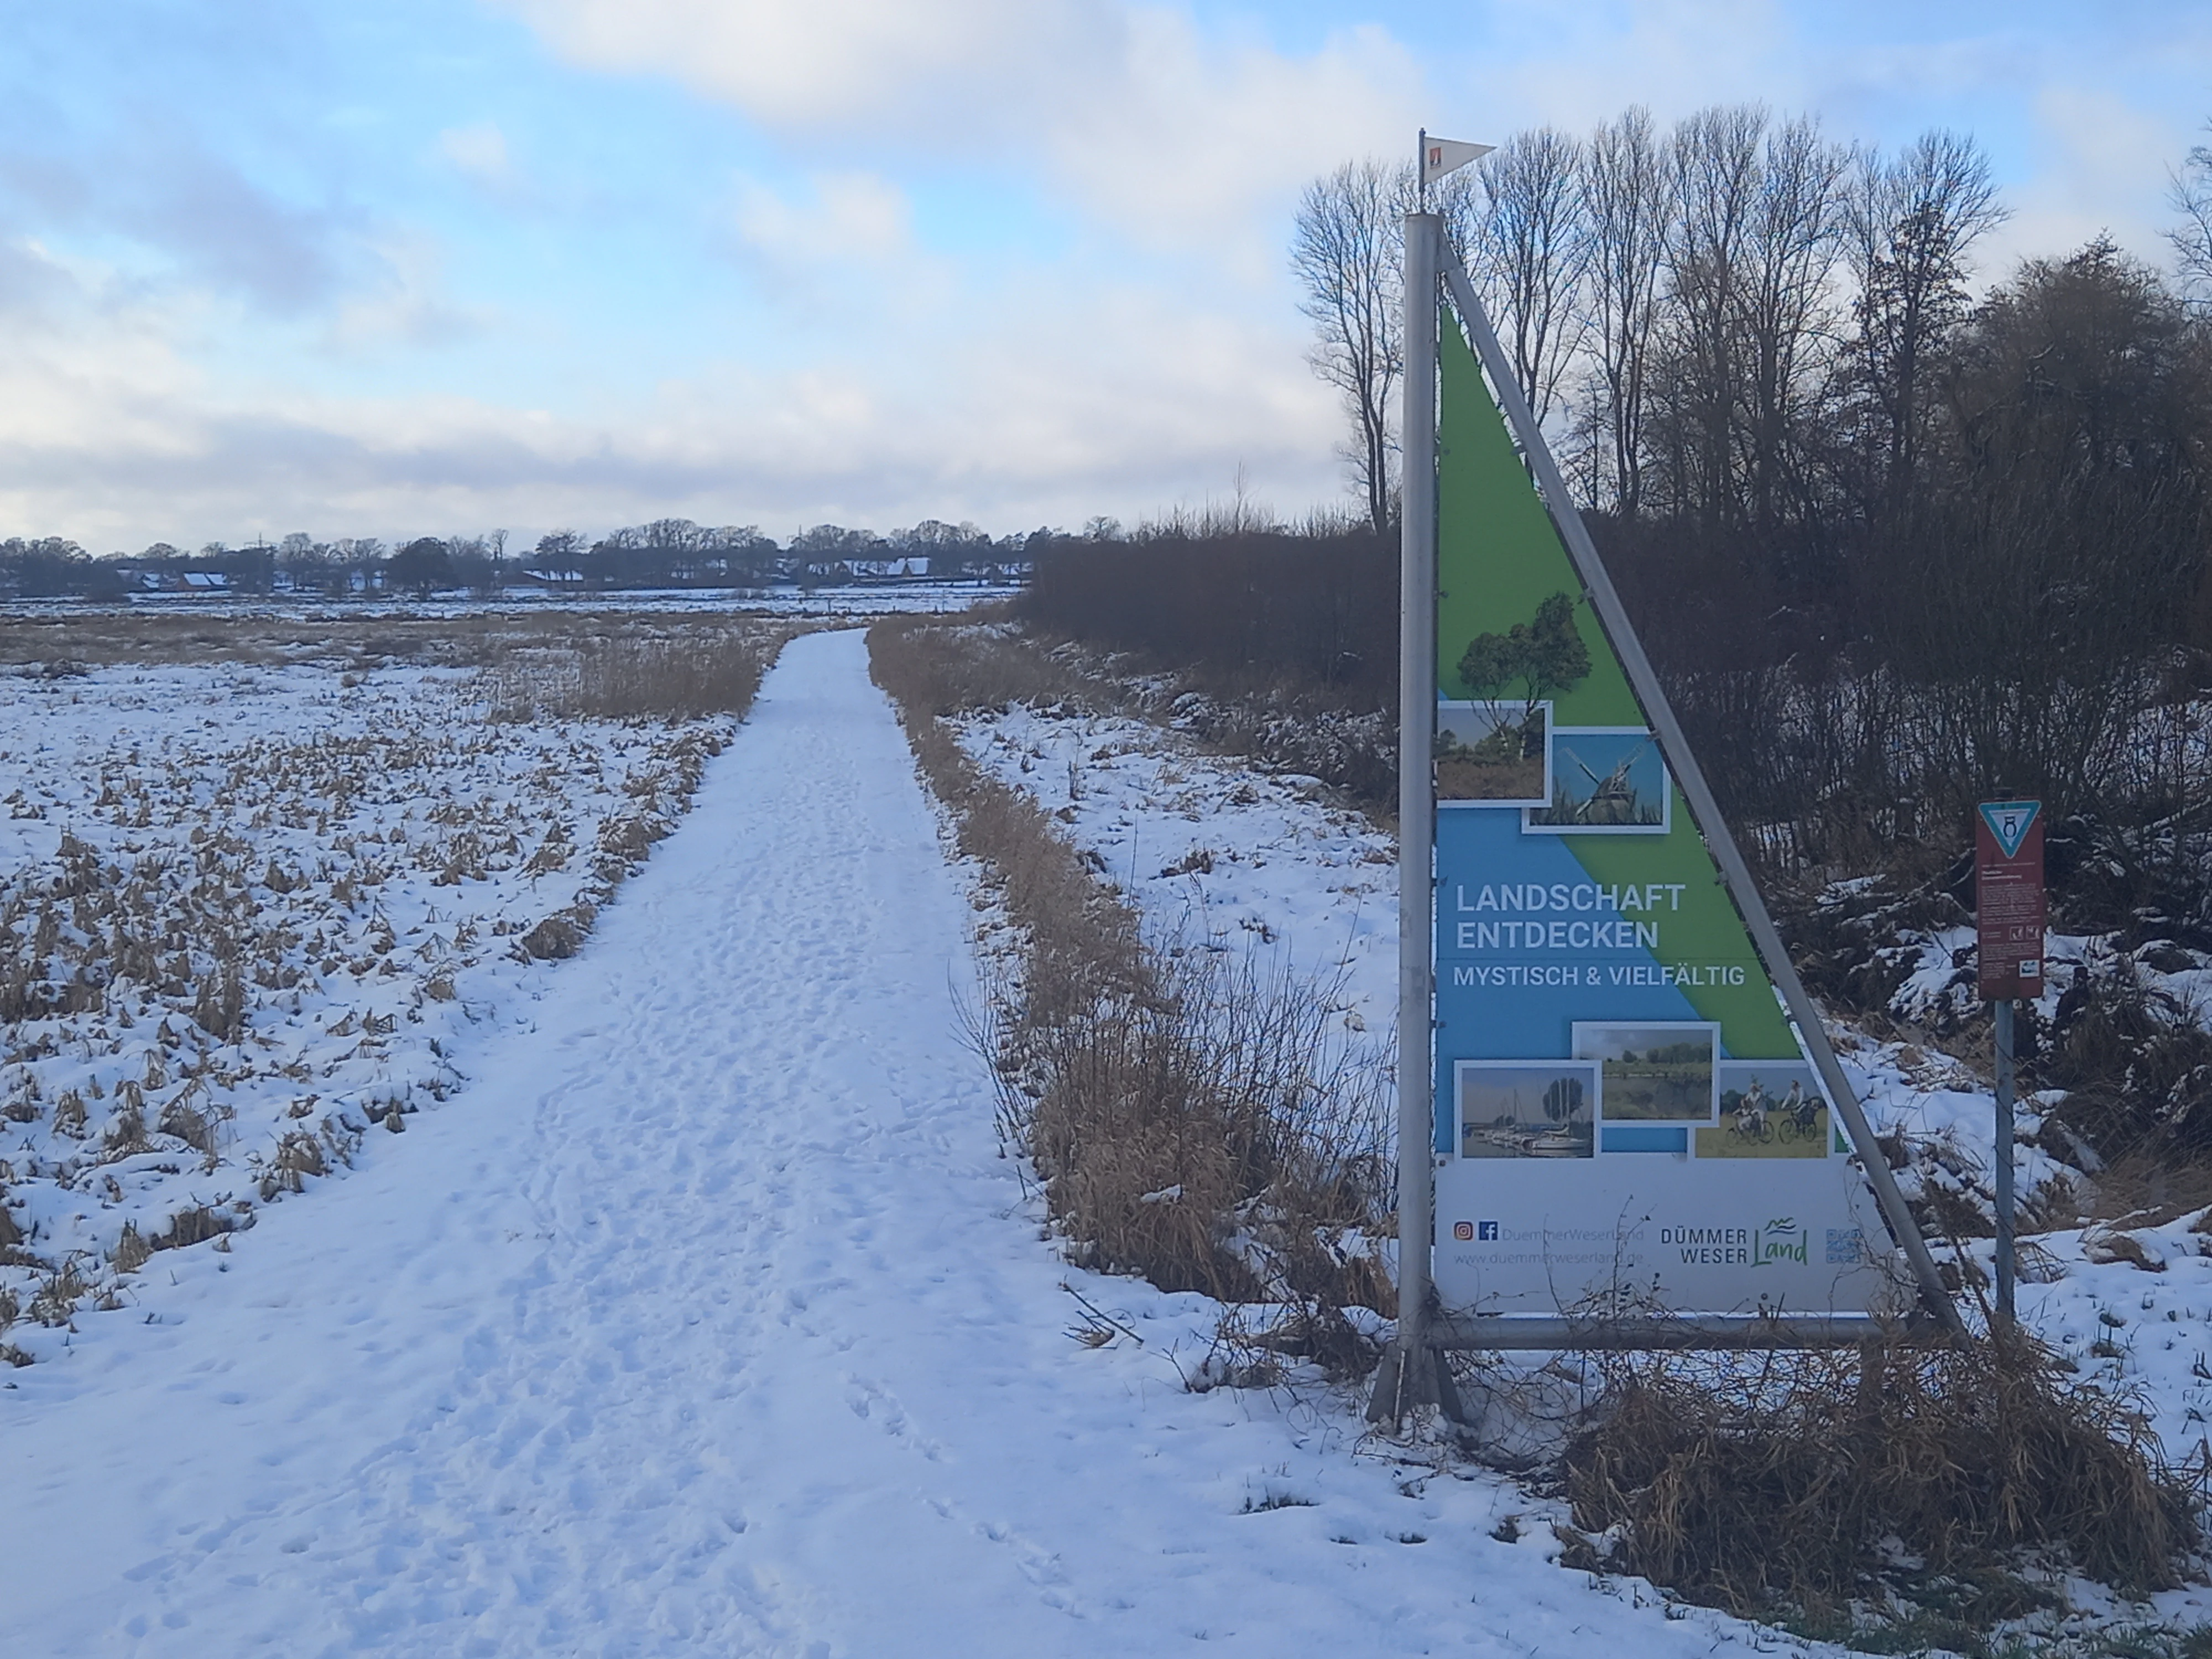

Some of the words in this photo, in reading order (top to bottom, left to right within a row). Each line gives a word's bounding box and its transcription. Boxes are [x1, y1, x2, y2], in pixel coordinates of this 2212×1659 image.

[1457, 884, 1686, 912] LANDSCHAFT
[1457, 922, 1658, 948] ENTDECKEN
[1453, 967, 1578, 986] MYSTISCH
[1586, 967, 1601, 985] &
[1610, 963, 1745, 986] VIELFÄLTIG
[1661, 1225, 1747, 1244] DÜMMER
[1681, 1248, 1747, 1264] WESER
[1750, 1229, 1808, 1267] Land
